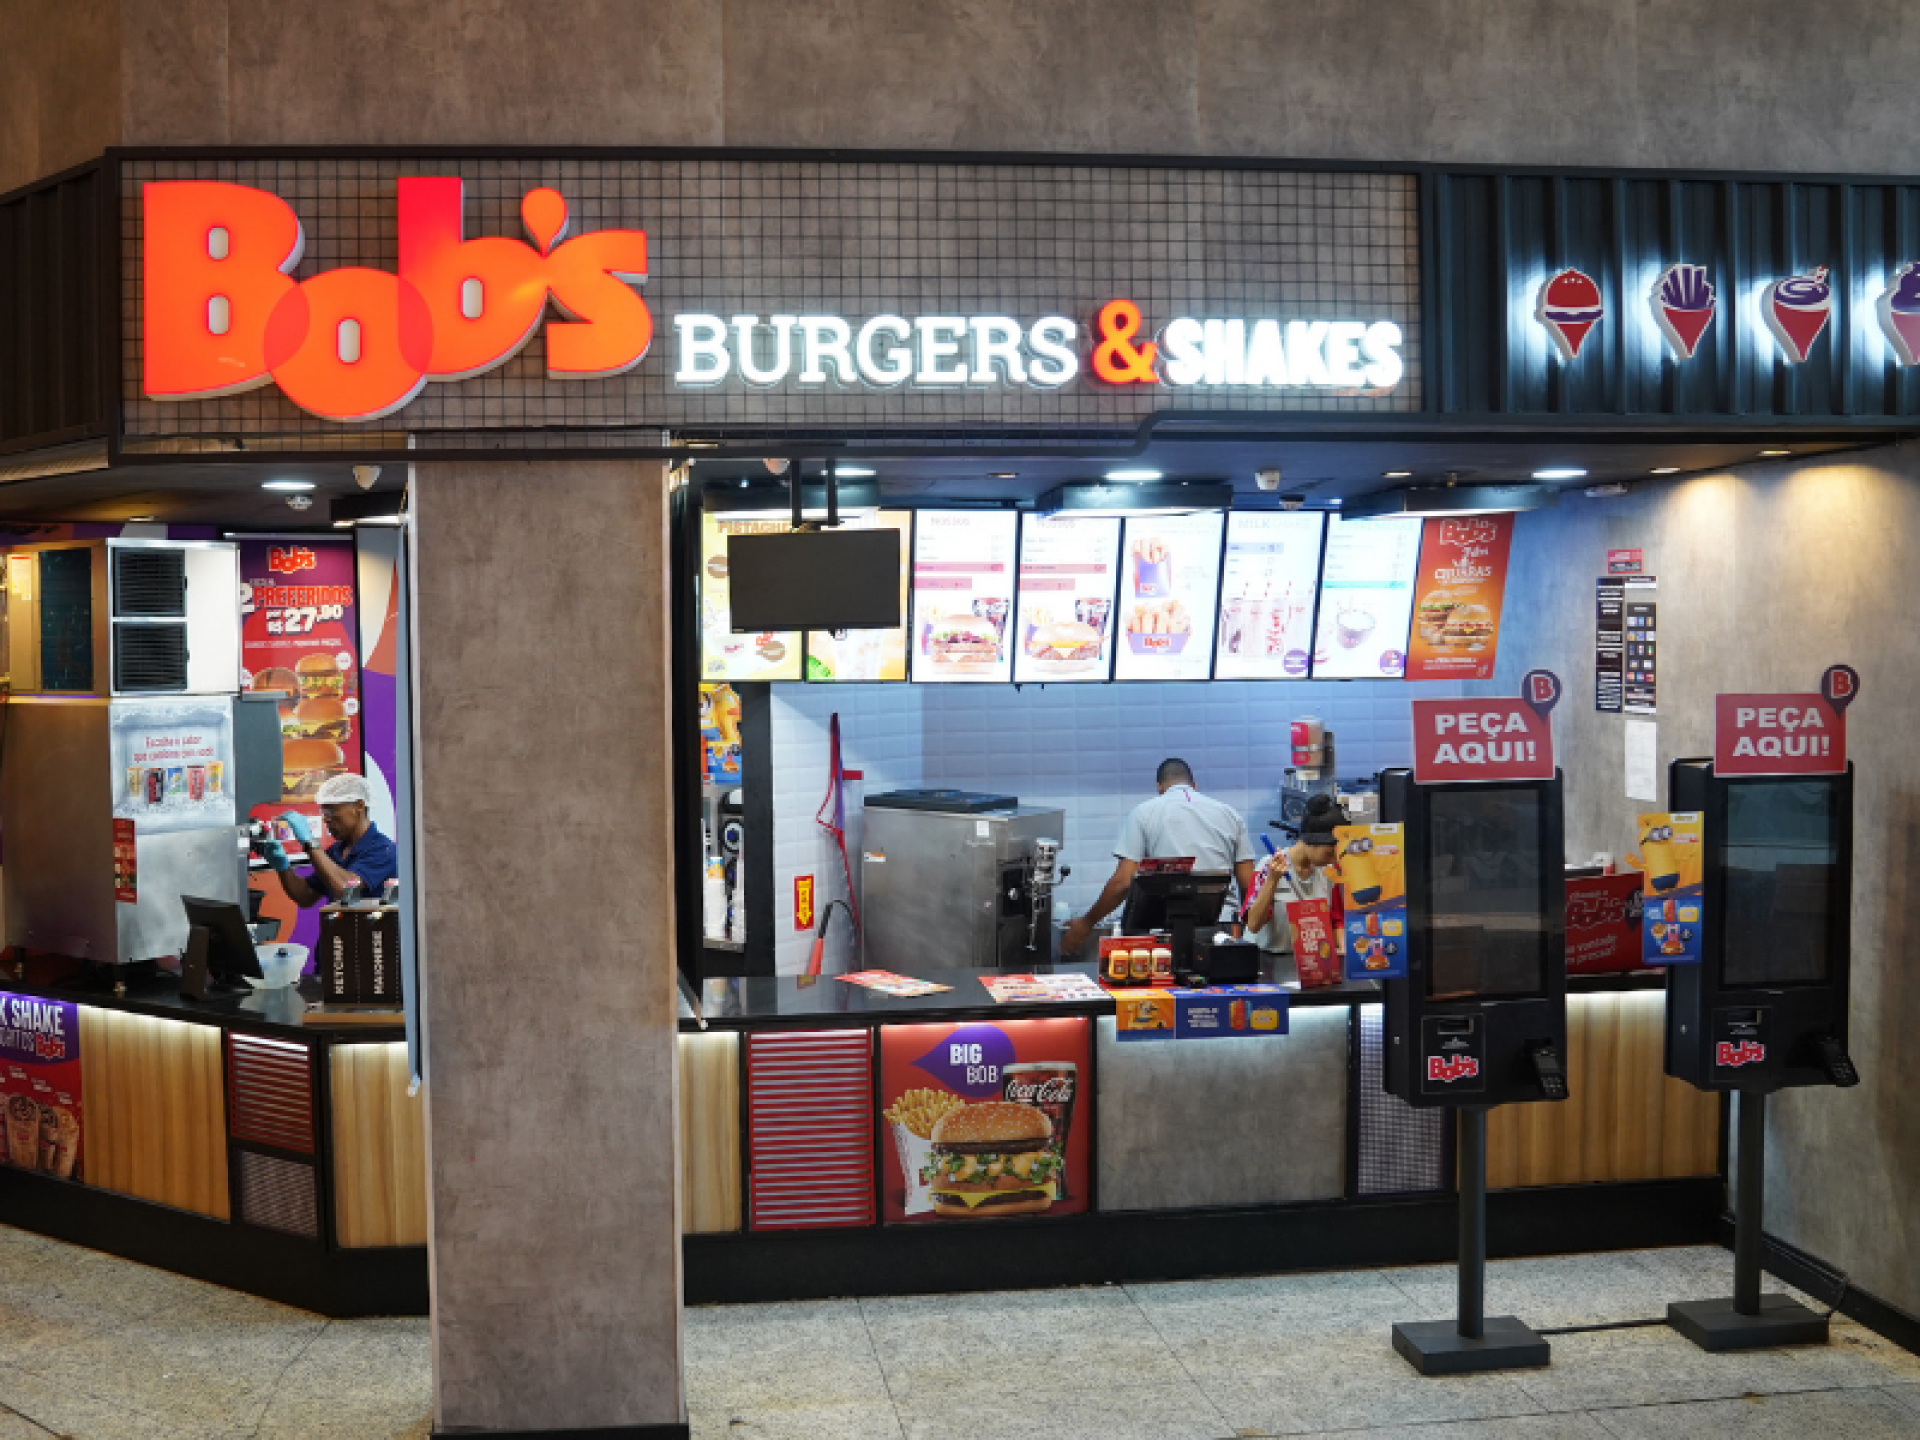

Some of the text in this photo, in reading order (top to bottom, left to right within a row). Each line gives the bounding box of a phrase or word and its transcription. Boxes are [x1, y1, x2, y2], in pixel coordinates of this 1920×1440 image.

[143, 177, 653, 421] Bob's
[673, 299, 1404, 388] BURGERS & SHAKES
[268, 546, 315, 574] Bob's
[254, 585, 353, 608] PREFERIDOS
[1434, 712, 1529, 739] PEÇA
[1736, 707, 1824, 732] PEÇA
[1433, 741, 1536, 764] AQUI!
[1732, 735, 1830, 758] AQUI!
[333, 935, 344, 995] KETCHUP
[12, 998, 65, 1036] SHAKE
[950, 1043, 983, 1066] BIG
[1716, 1040, 1766, 1067] Bob's
[966, 1065, 998, 1084] BOB
[1427, 1054, 1479, 1082] Bob's
